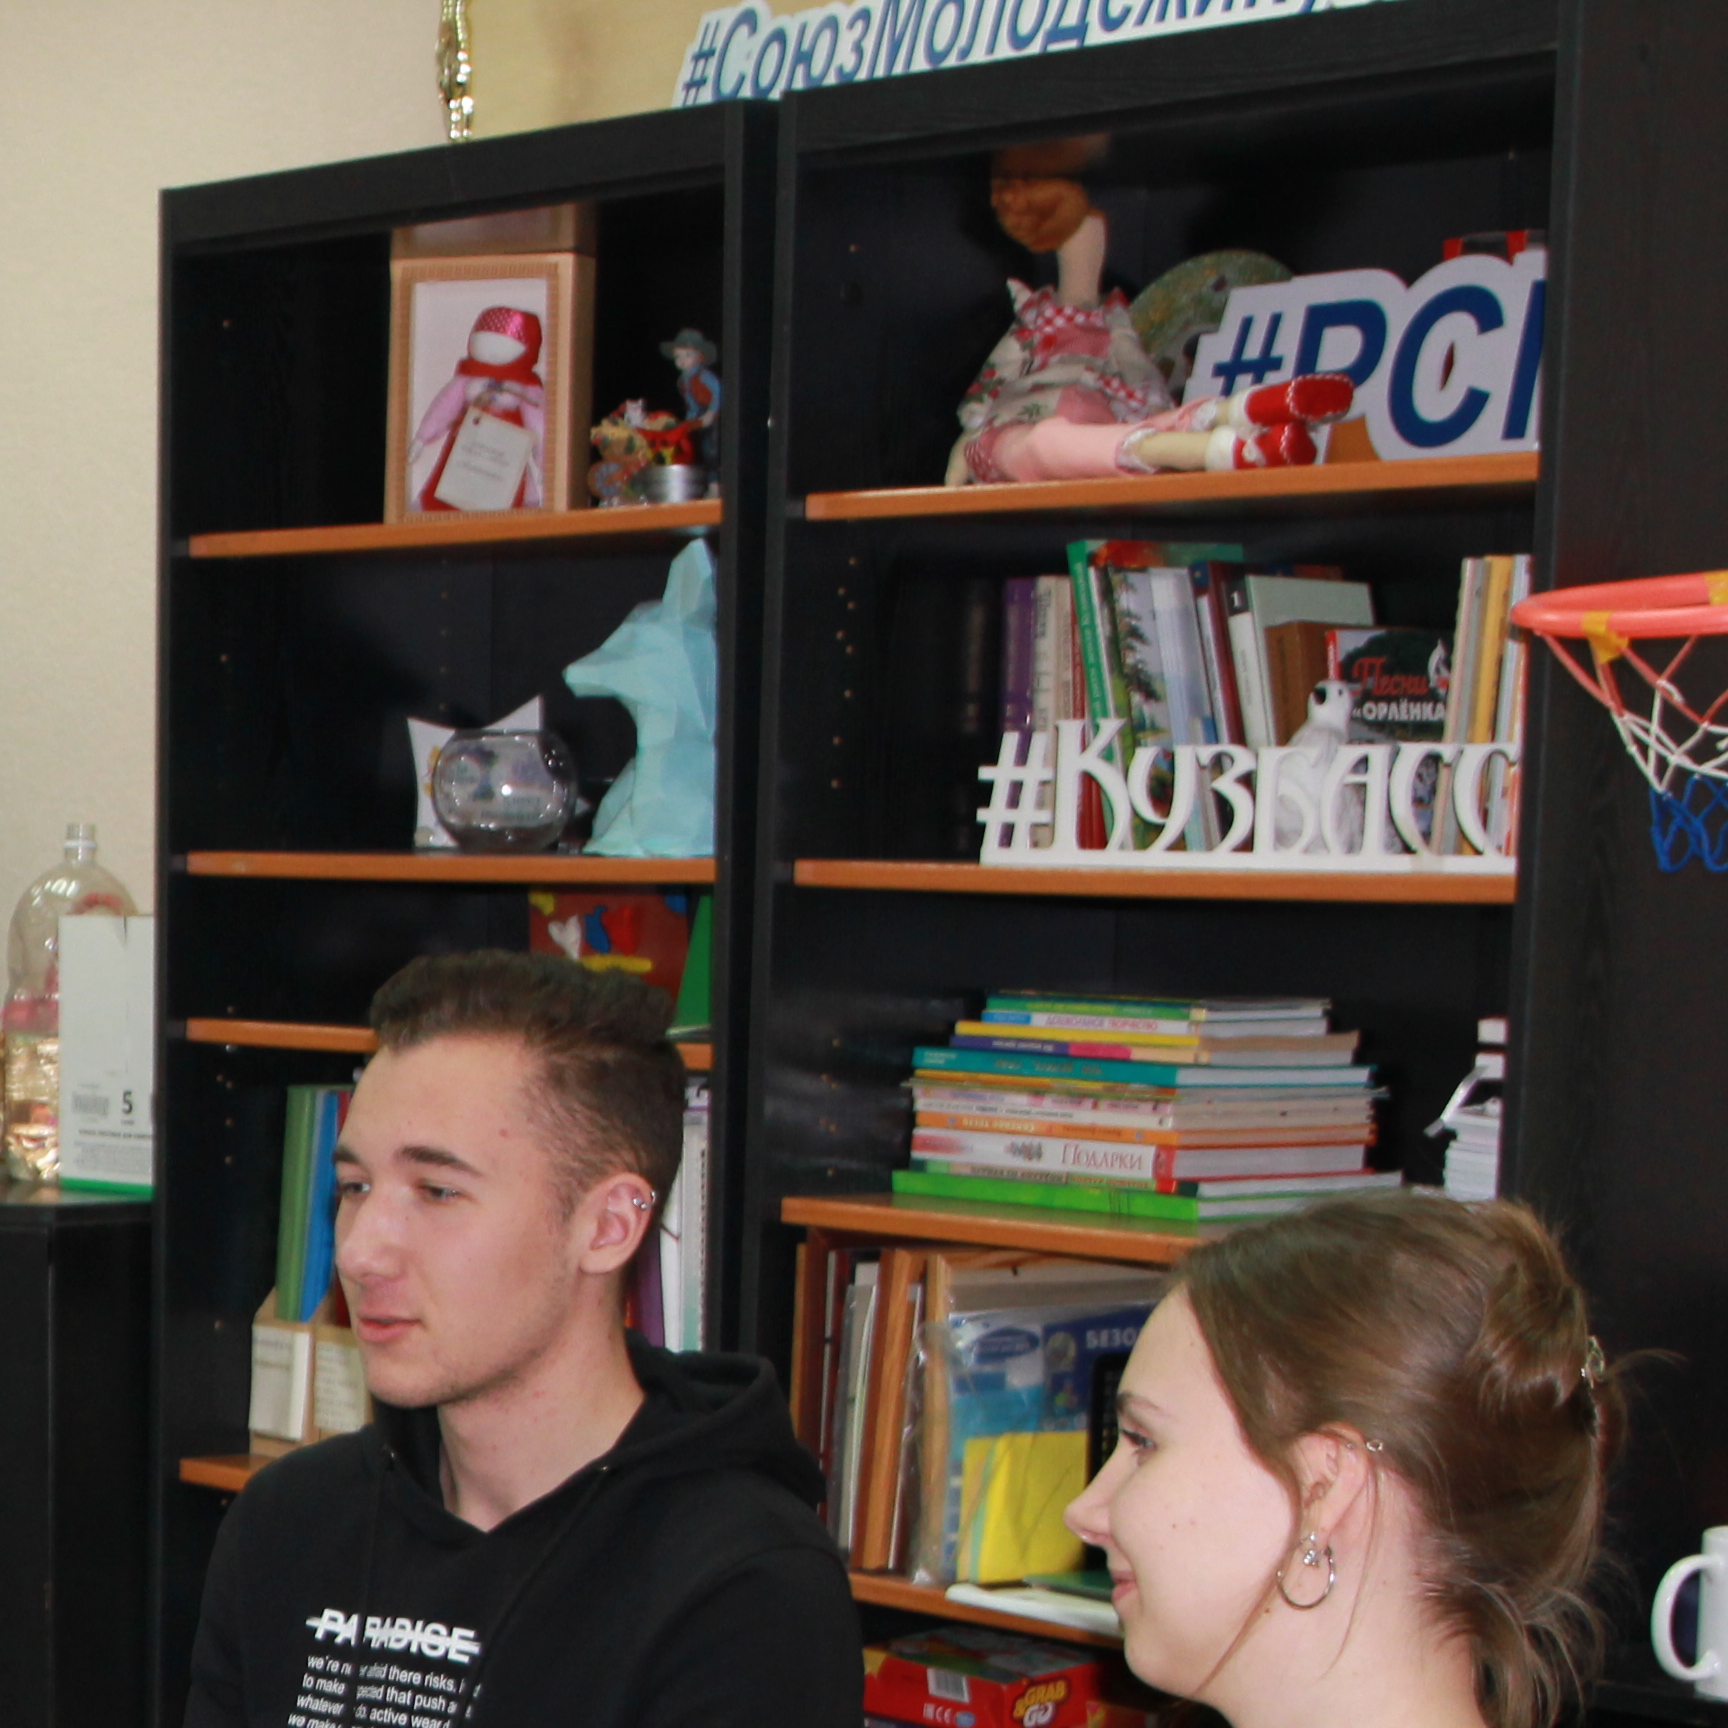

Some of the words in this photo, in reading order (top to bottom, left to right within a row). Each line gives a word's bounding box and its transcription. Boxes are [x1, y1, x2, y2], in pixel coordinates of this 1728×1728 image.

[122, 1091, 133, 1114] 5
[303, 1673, 314, 1688] to
[316, 1679, 345, 1695] make
[386, 1686, 412, 1706] that
[413, 1694, 446, 1711] push
[389, 1665, 421, 1685] there
[424, 1672, 457, 1693] risks.
[288, 1713, 306, 1727] we
[297, 1694, 344, 1716] whatever
[369, 1707, 408, 1726] active
